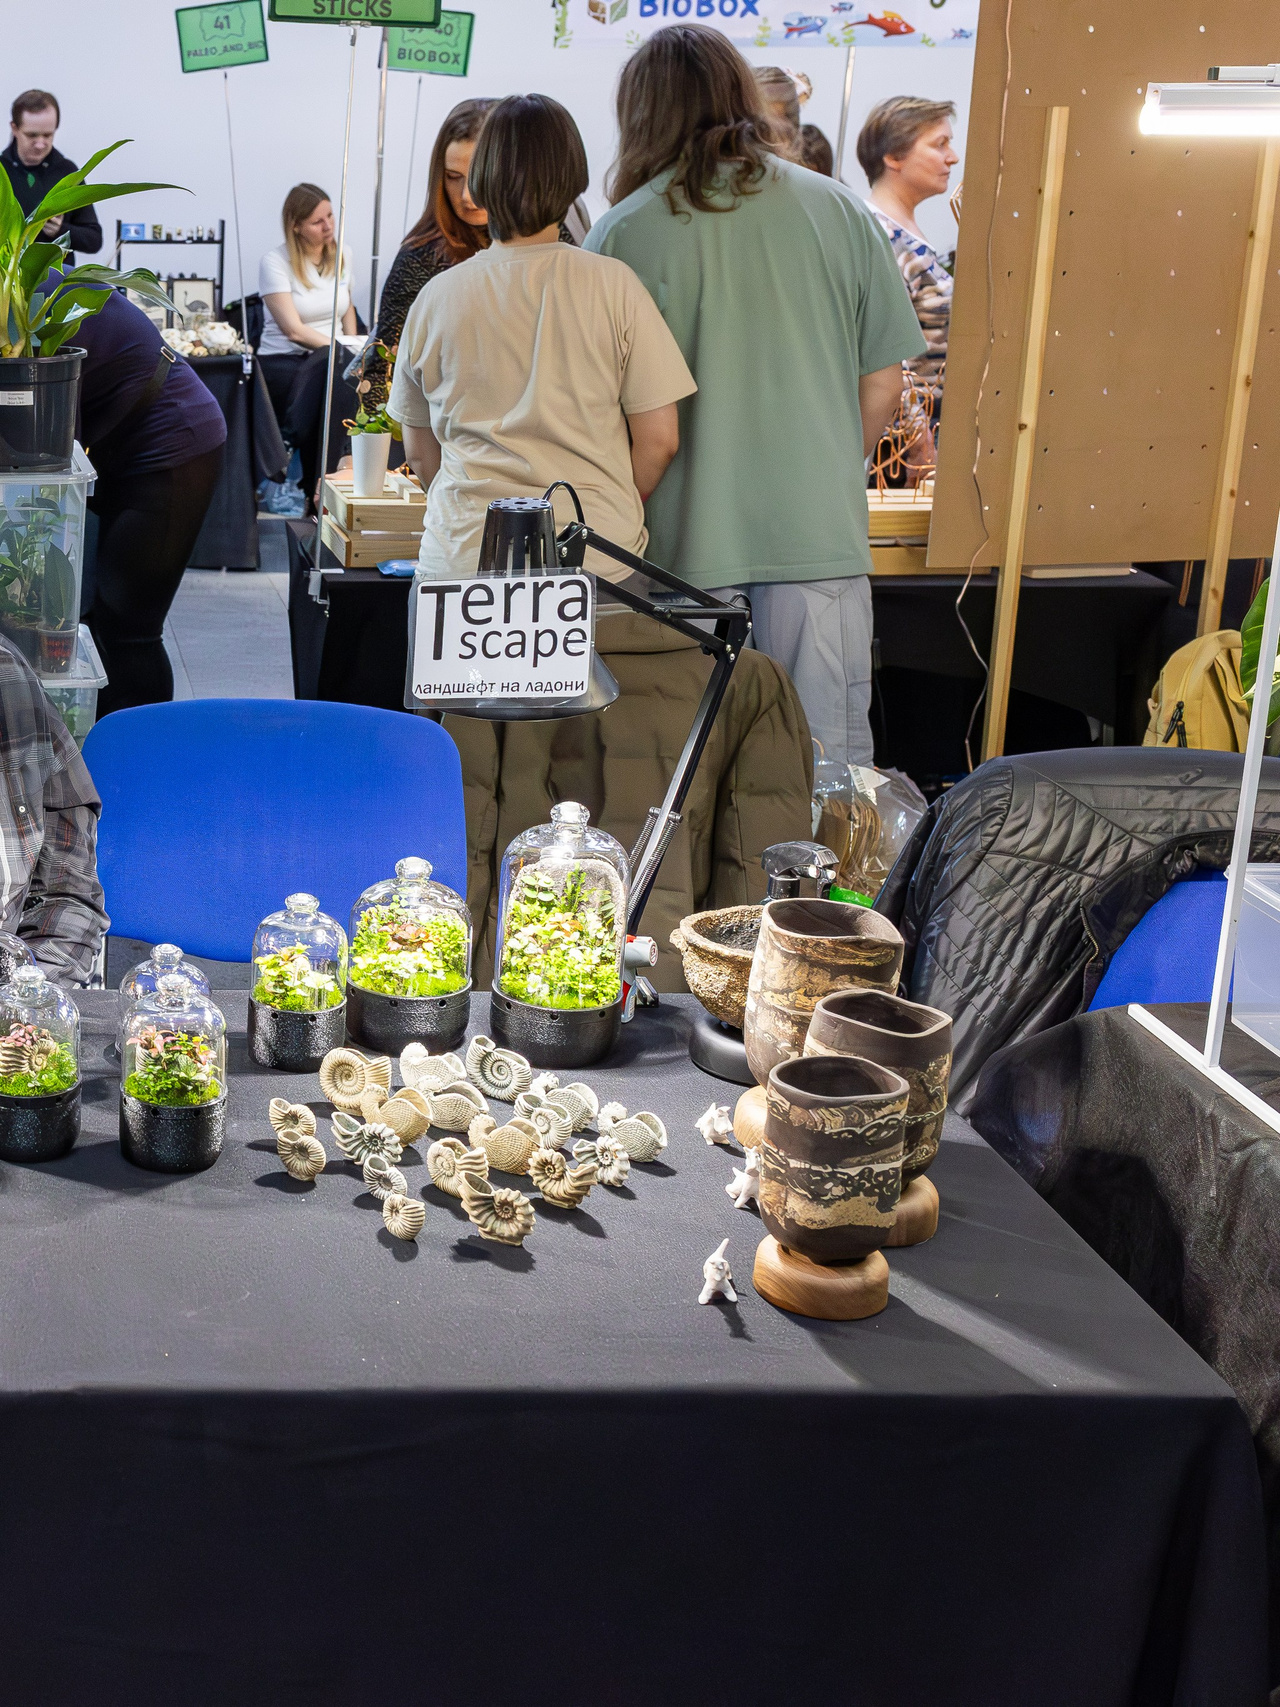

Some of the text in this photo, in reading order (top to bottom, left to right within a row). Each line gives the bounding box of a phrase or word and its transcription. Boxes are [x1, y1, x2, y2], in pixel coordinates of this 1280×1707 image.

[313, 0, 393, 18] STICKS
[639, 0, 760, 18] BIOBOX
[213, 14, 231, 30] 41
[397, 47, 461, 65] BIOBOX
[420, 579, 588, 661] Terra
[458, 627, 588, 668] scape
[414, 680, 584, 696] ландшафт на ладони
